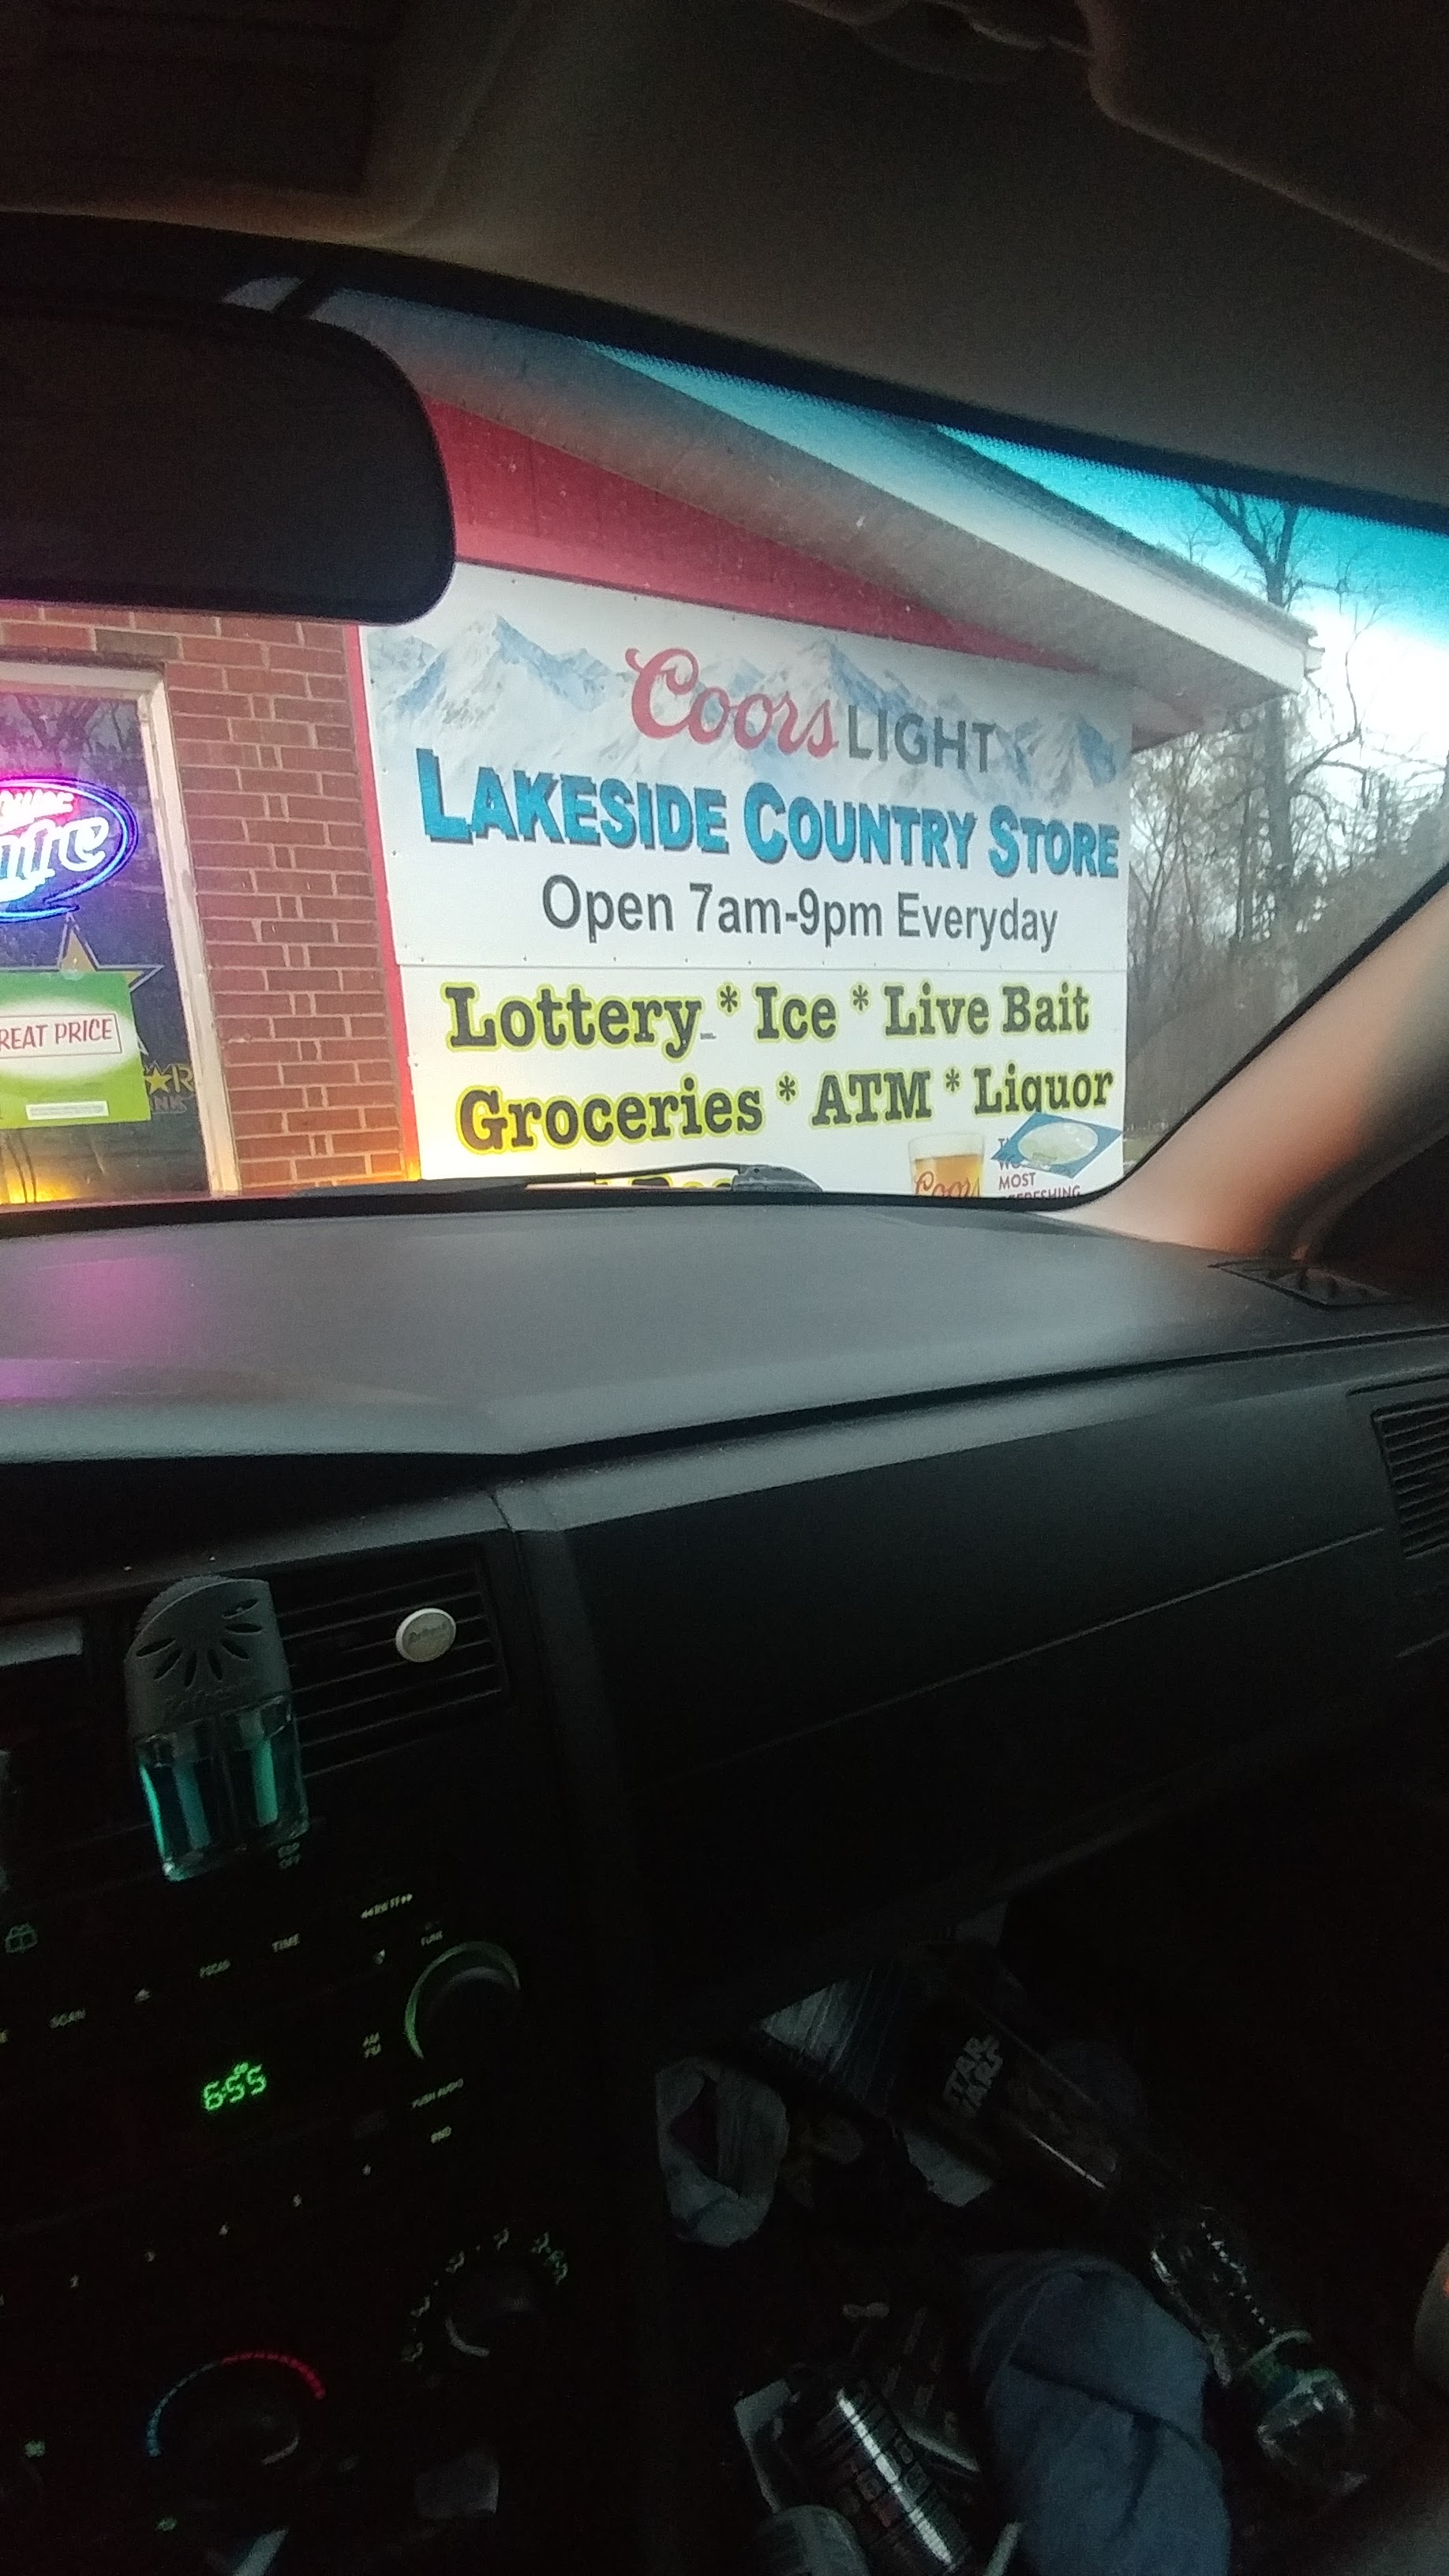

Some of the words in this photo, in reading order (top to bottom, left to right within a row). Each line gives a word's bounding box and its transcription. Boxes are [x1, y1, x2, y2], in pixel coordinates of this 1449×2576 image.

[625, 647, 838, 759] Coors
[848, 705, 996, 773] LIGHT
[415, 748, 729, 855] LAKESIDE
[743, 781, 977, 870] COUNTRY
[988, 805, 1119, 879] STORE
[542, 874, 673, 943] Open
[689, 883, 883, 949] 7am-9pm
[897, 893, 1058, 953] Everyday
[54, 1018, 112, 1044] PRICE
[444, 985, 702, 1059] Lottery
[756, 987, 837, 1040] Ice
[886, 983, 990, 1035] Live
[1002, 983, 1089, 1032] Bait
[459, 1077, 762, 1150] Groceries
[811, 1072, 931, 1124] ATM
[974, 1062, 1113, 1114] Liquor
[998, 1173, 1035, 1190] MOST
